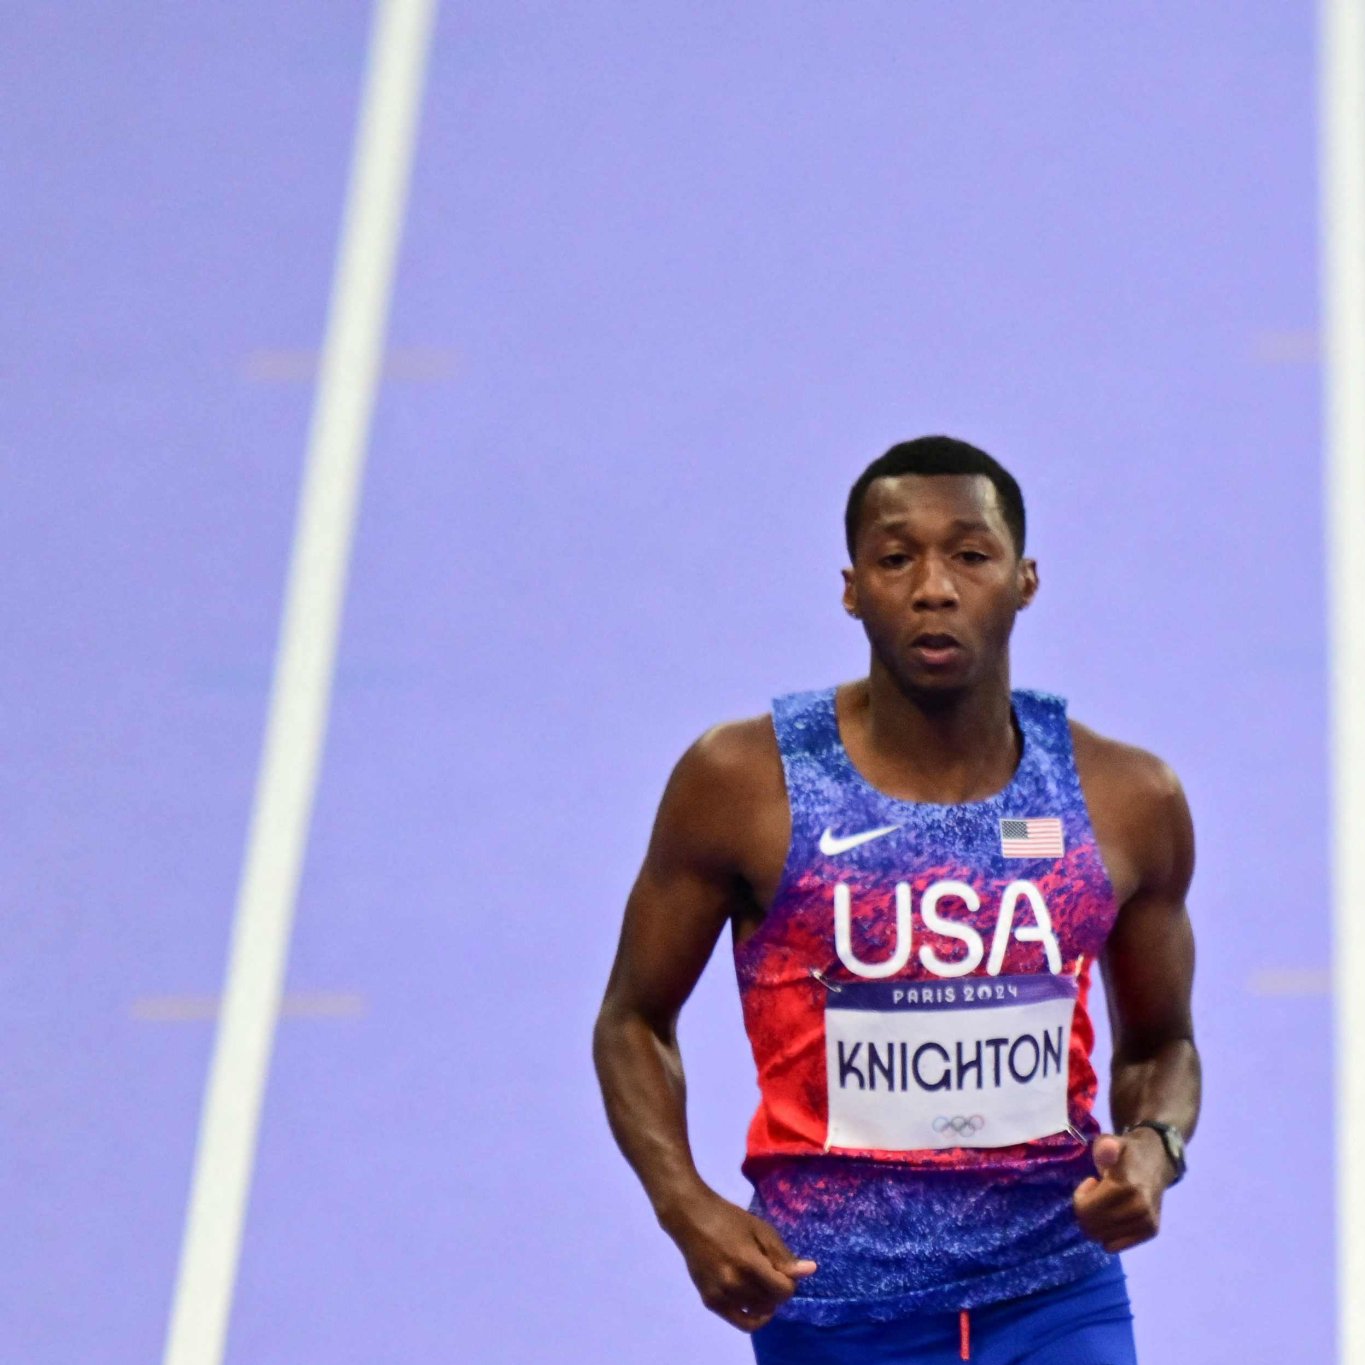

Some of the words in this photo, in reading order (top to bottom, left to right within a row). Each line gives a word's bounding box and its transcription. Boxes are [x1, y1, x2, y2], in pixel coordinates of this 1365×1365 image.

[833, 879, 1063, 979] USA
[892, 985, 956, 1005] PARIS
[963, 983, 1018, 1003] 2024
[837, 1025, 1064, 1093] KNIGHTON
